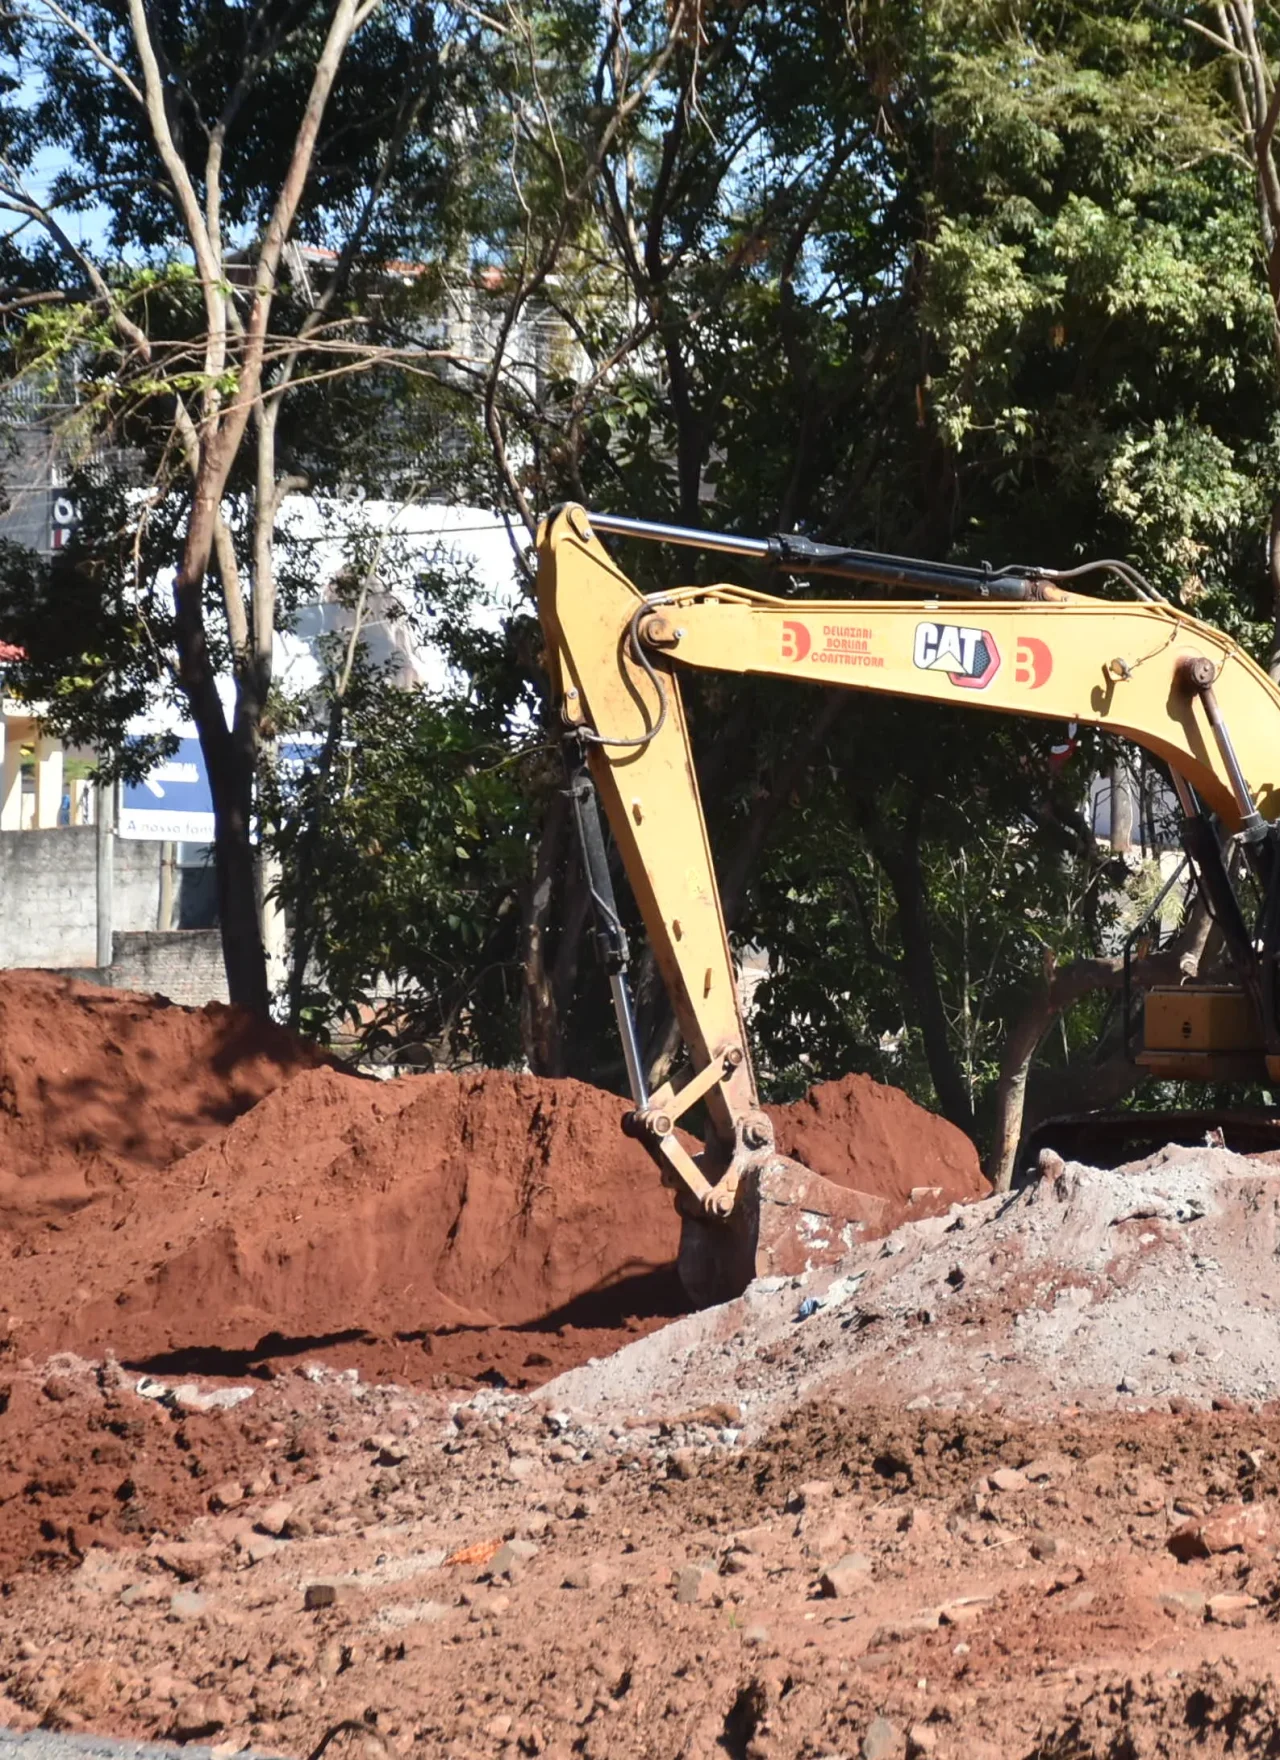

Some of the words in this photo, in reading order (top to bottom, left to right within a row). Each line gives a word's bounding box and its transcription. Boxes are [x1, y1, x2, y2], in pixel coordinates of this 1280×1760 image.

[826, 638, 868, 650] BORLINA
[914, 621, 983, 676] CAT
[811, 652, 884, 668] CONSTRUTORA
